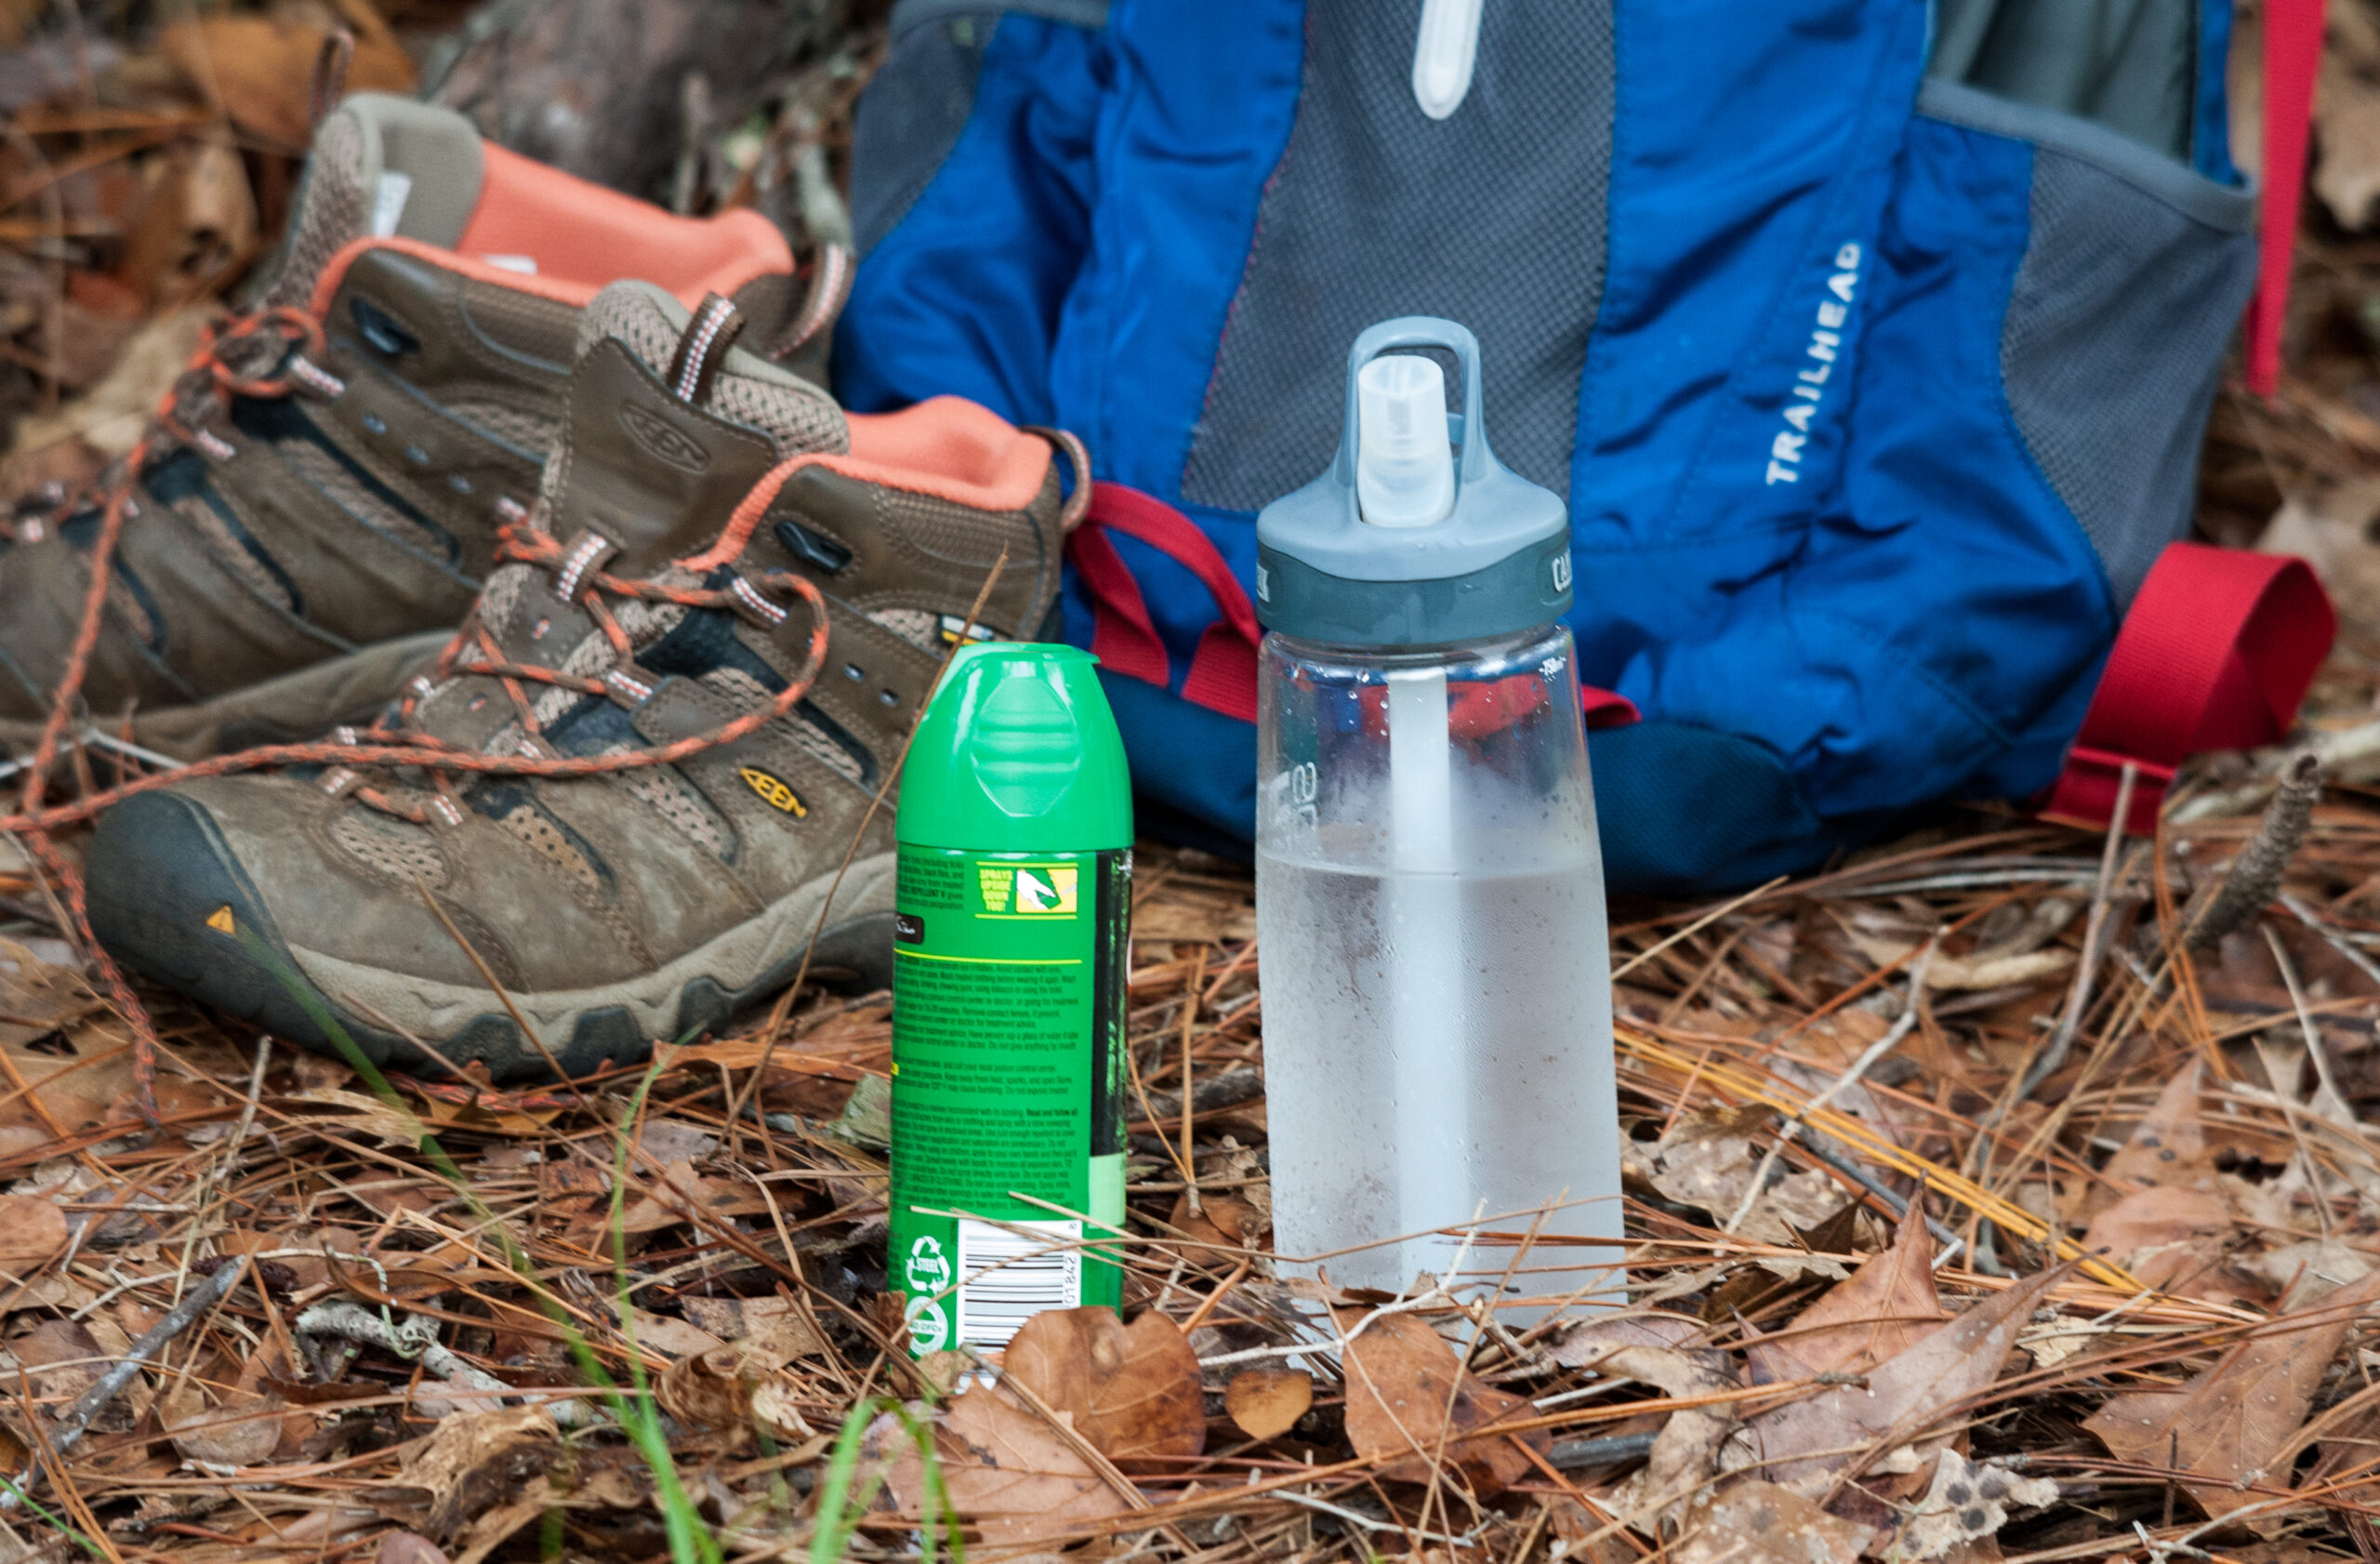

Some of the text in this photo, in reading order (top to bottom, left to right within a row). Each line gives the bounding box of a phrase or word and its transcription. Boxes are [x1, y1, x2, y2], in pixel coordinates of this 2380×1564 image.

[1766, 243, 1859, 485] TRAILHEAD
[740, 767, 807, 817] KEEN
[980, 869, 1012, 881] SPRAYS
[916, 1257, 940, 1273] STEEL
